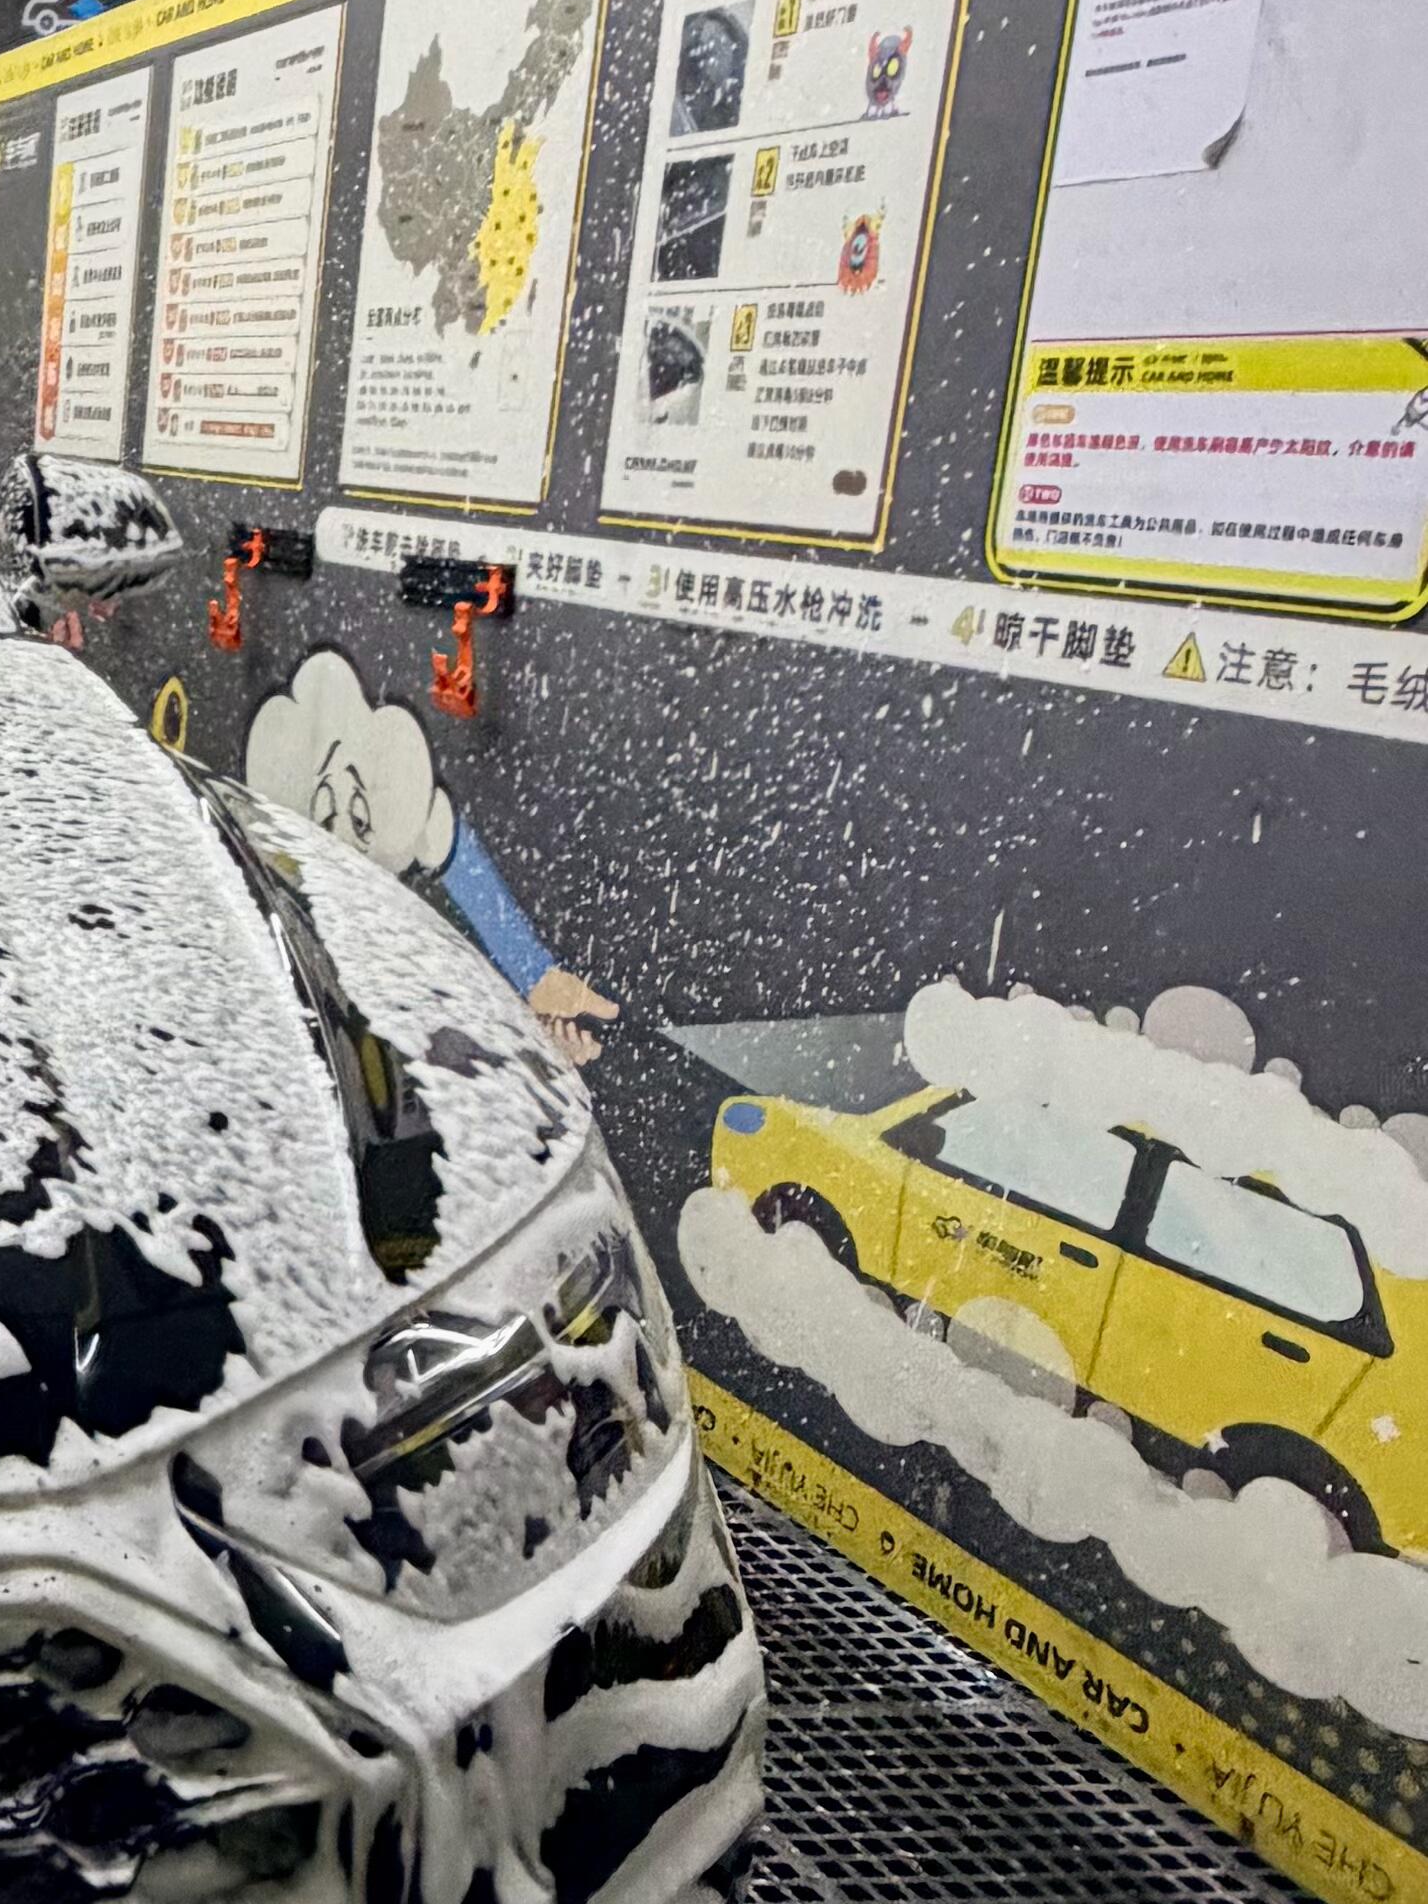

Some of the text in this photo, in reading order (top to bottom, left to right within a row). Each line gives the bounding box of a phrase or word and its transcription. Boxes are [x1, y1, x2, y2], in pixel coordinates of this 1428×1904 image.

[1036, 356, 1135, 386] 温馨提示
[674, 567, 884, 633] 使用高压水枪冲洗
[991, 609, 1136, 669] 晾干脚垫
[910, 1552, 999, 1629] HOME
[1004, 1617, 1077, 1681] AND
[1082, 1666, 1149, 1735] CAR
